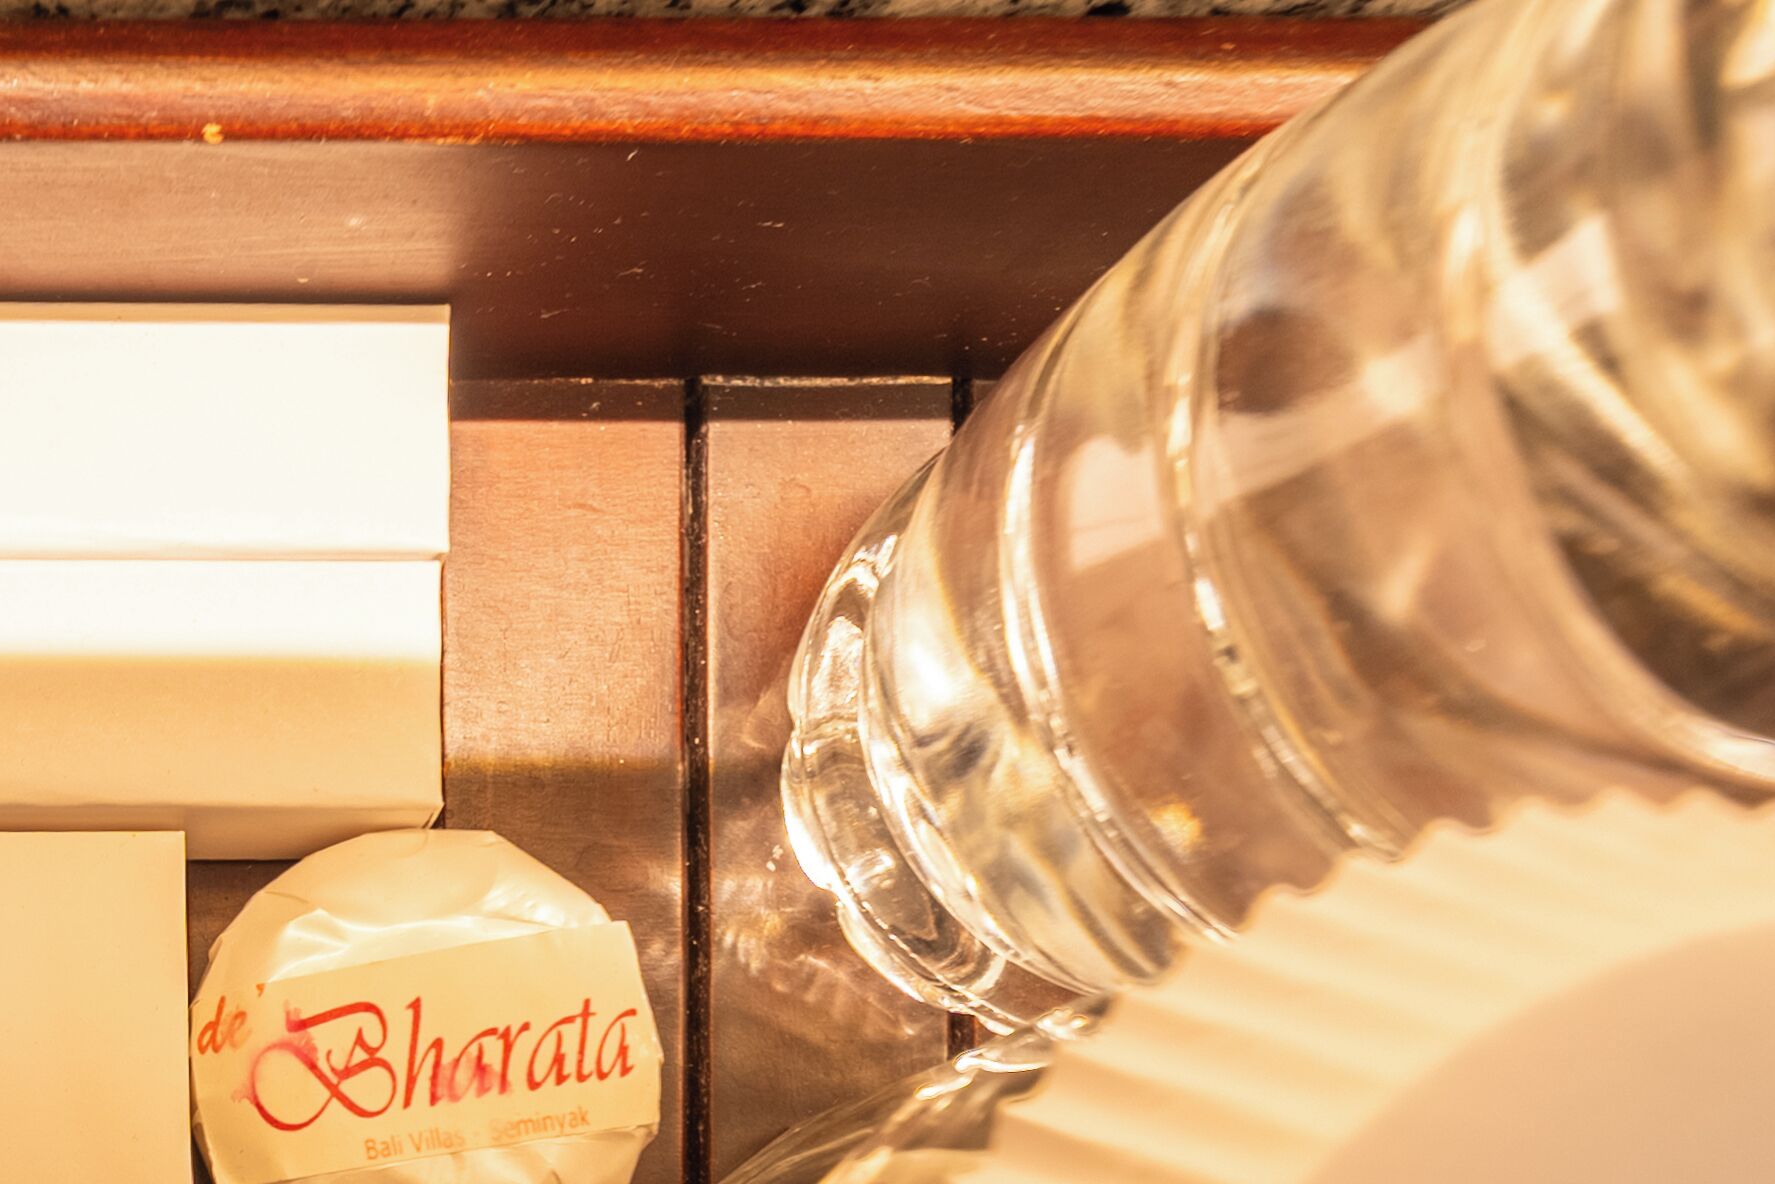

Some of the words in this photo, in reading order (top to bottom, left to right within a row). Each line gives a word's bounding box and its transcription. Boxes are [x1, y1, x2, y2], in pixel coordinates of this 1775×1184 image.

[246, 996, 638, 1132] Bharata
[365, 1136, 404, 1162] Bali
[411, 1128, 466, 1155] Villas
[490, 1105, 591, 1142] Seminyak
